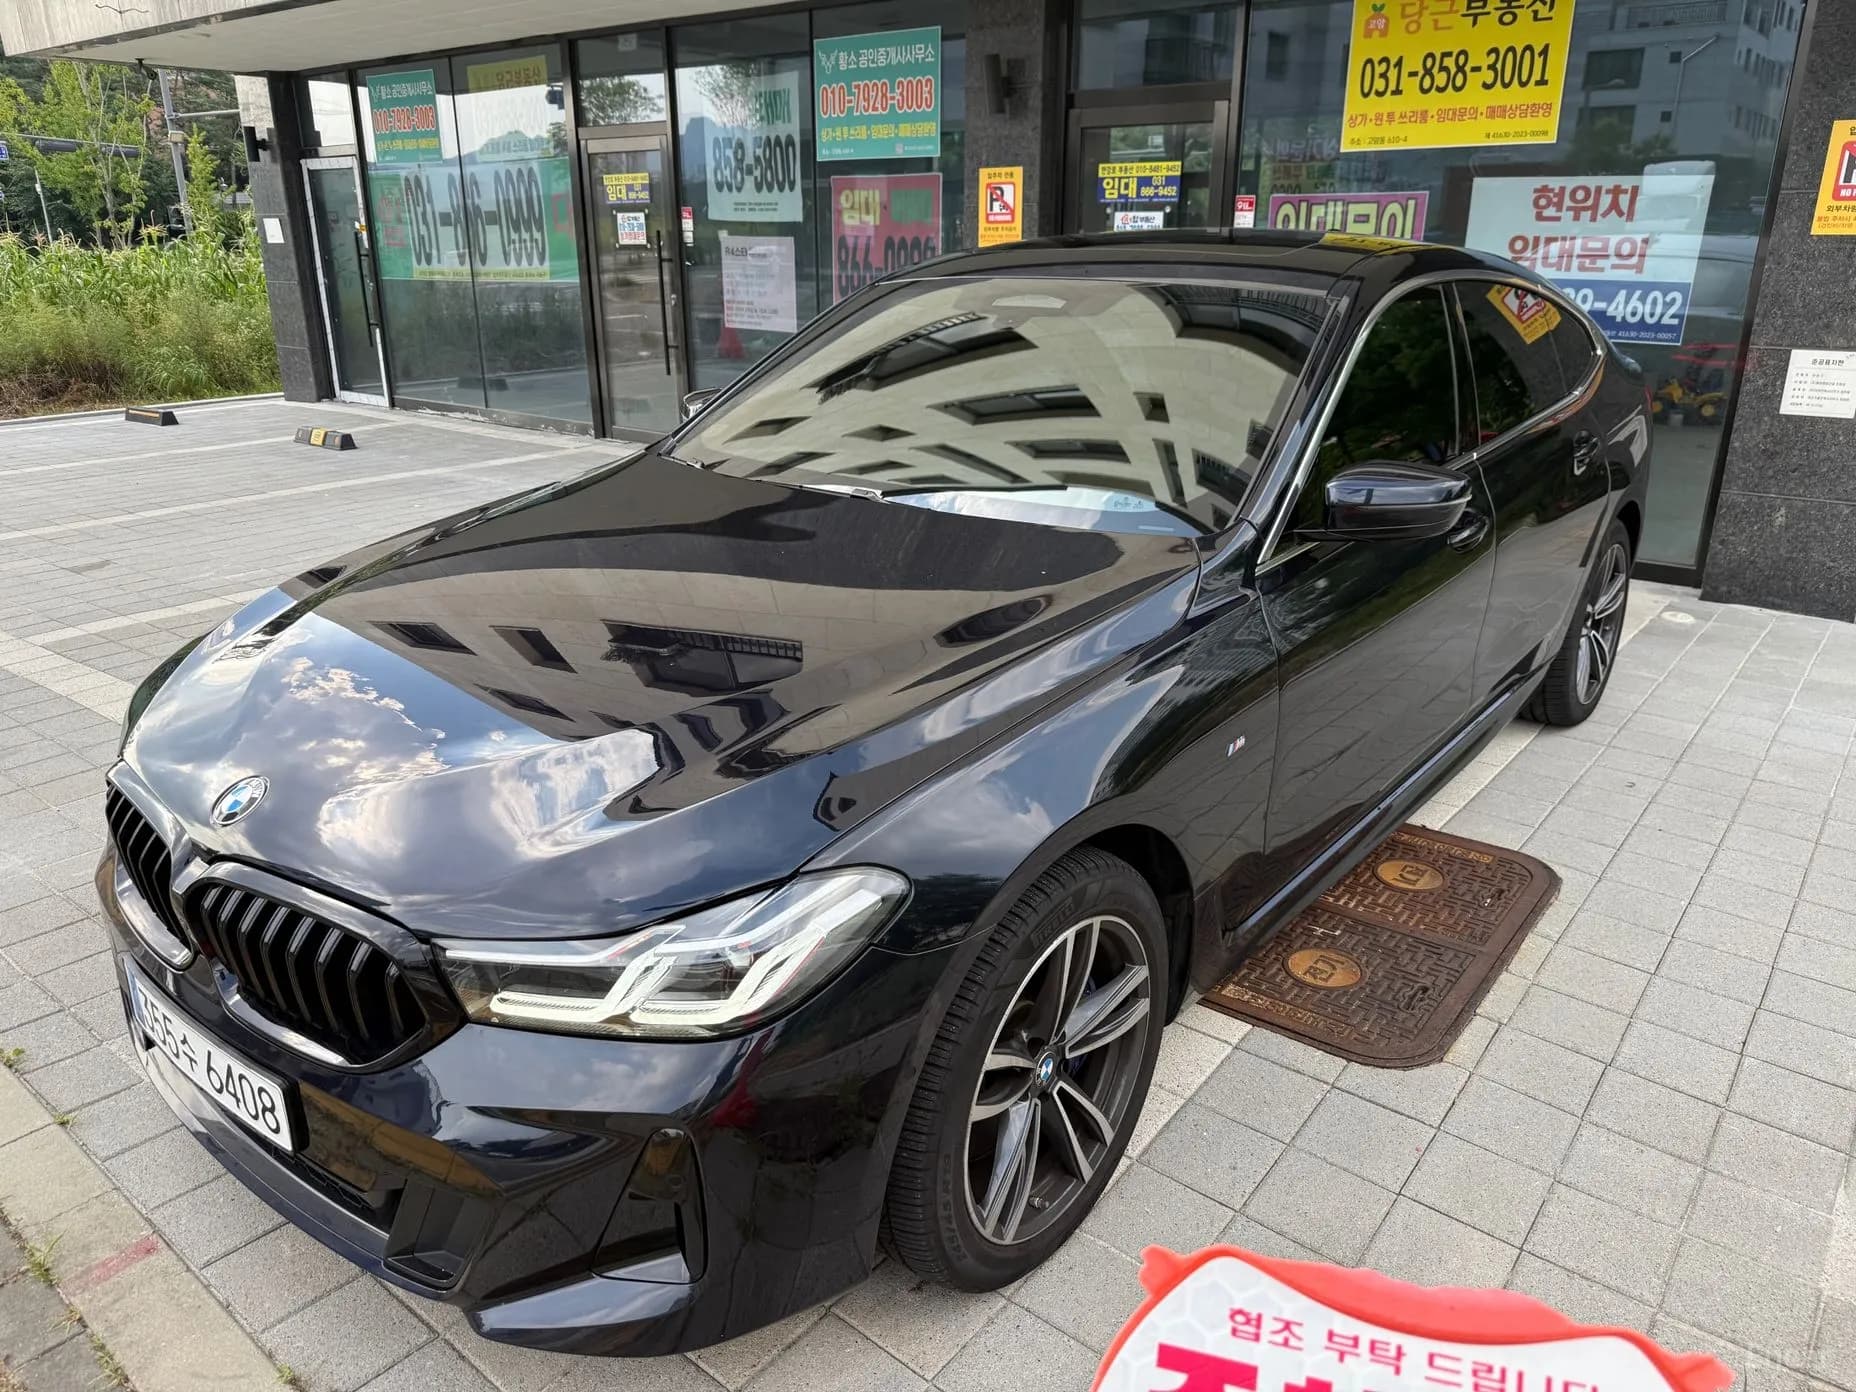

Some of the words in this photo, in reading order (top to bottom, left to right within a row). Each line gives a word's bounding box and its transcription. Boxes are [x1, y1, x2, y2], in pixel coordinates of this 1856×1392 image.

[838, 50, 857, 70] 황소
[859, 43, 935, 68] 공인중개사사무소
[1360, 43, 1550, 99] 031-858-3001
[820, 75, 935, 118] 010-7928-3003
[712, 134, 797, 193] 858-5800
[607, 184, 627, 200] 임대
[840, 189, 881, 226] 임대
[1103, 177, 1137, 198] 임대
[1532, 184, 1640, 223] 현위치
[138, 987, 199, 1072] 355수
[206, 1050, 281, 1135] 6408
[1228, 1307, 1304, 1352] 협조
[1324, 1328, 1407, 1376] 부탁
